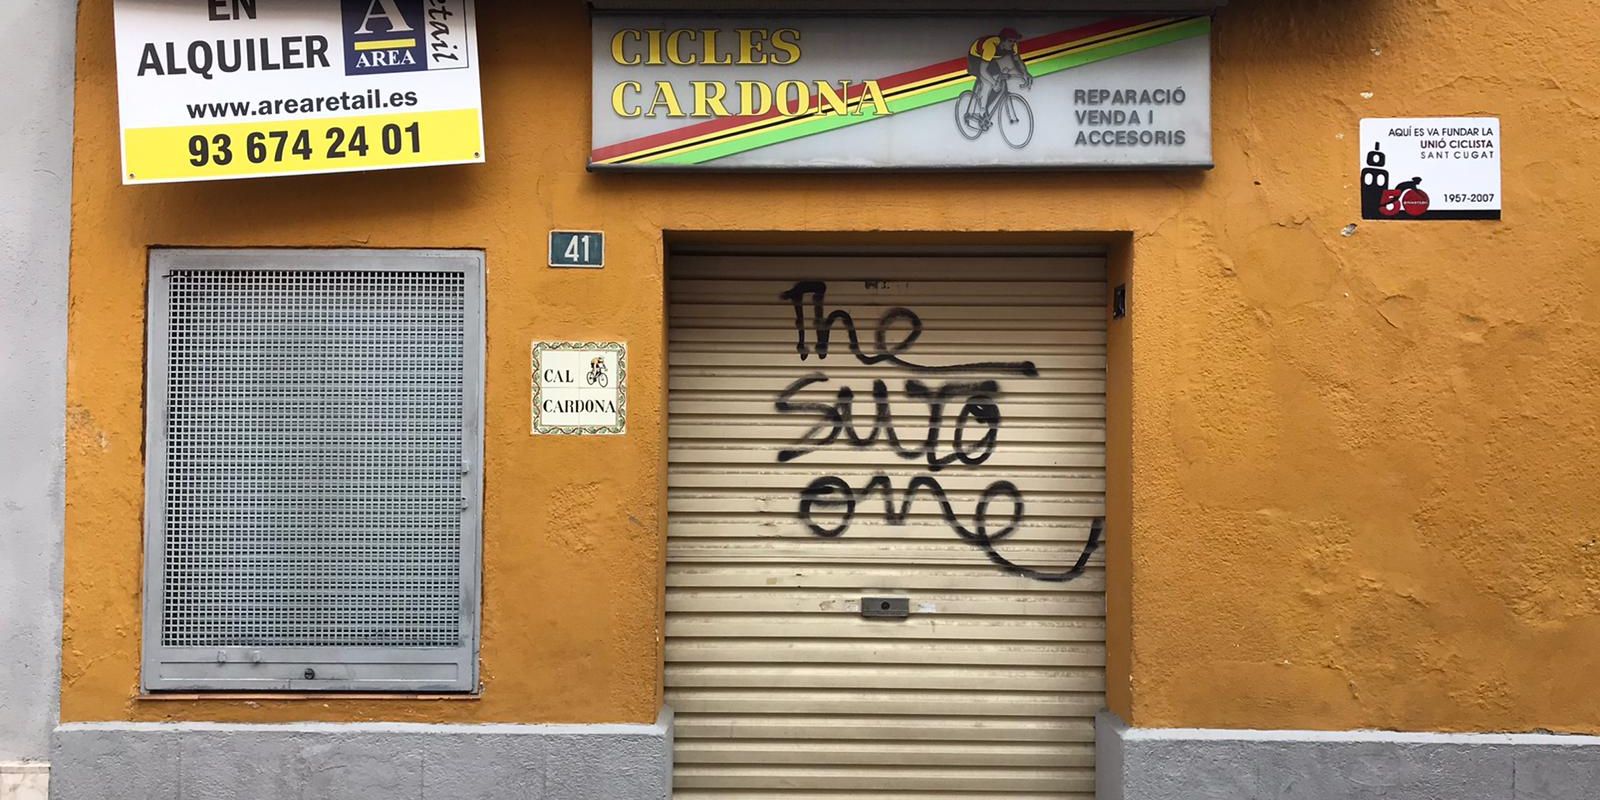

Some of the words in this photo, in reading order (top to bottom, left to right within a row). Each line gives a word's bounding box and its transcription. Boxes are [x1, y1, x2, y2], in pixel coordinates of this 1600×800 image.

[208, 0, 257, 21] EN
[611, 28, 801, 65] CICLES
[137, 35, 330, 79] ALQUILER
[355, 49, 417, 68] AREA
[186, 89, 418, 119] www.arearetail.es
[611, 79, 893, 117] CARDONA
[1074, 86, 1187, 106] REPARACIÓ
[1075, 109, 1141, 126] VENDA
[1148, 109, 1154, 125] I
[1074, 130, 1187, 146] ACCESORIS
[1388, 125, 1412, 137] AQUÍ
[1414, 128, 1425, 137] ES
[1427, 128, 1440, 136] VA
[1442, 128, 1479, 136] FUNDAR
[1482, 128, 1494, 136] LA
[188, 134, 233, 167] 93
[246, 129, 313, 162] 674
[325, 125, 369, 159] 24
[381, 122, 421, 155] 01
[1420, 138, 1447, 149] UNIÓ
[1449, 140, 1494, 149] CICLISTA
[1421, 151, 1449, 159] SANT
[1454, 151, 1494, 159] CUGAT
[1444, 194, 1495, 204] 1957-2007
[564, 235, 591, 262] 41
[780, 280, 1039, 376] The
[544, 369, 575, 384] CAL
[543, 399, 617, 414] CARDONA
